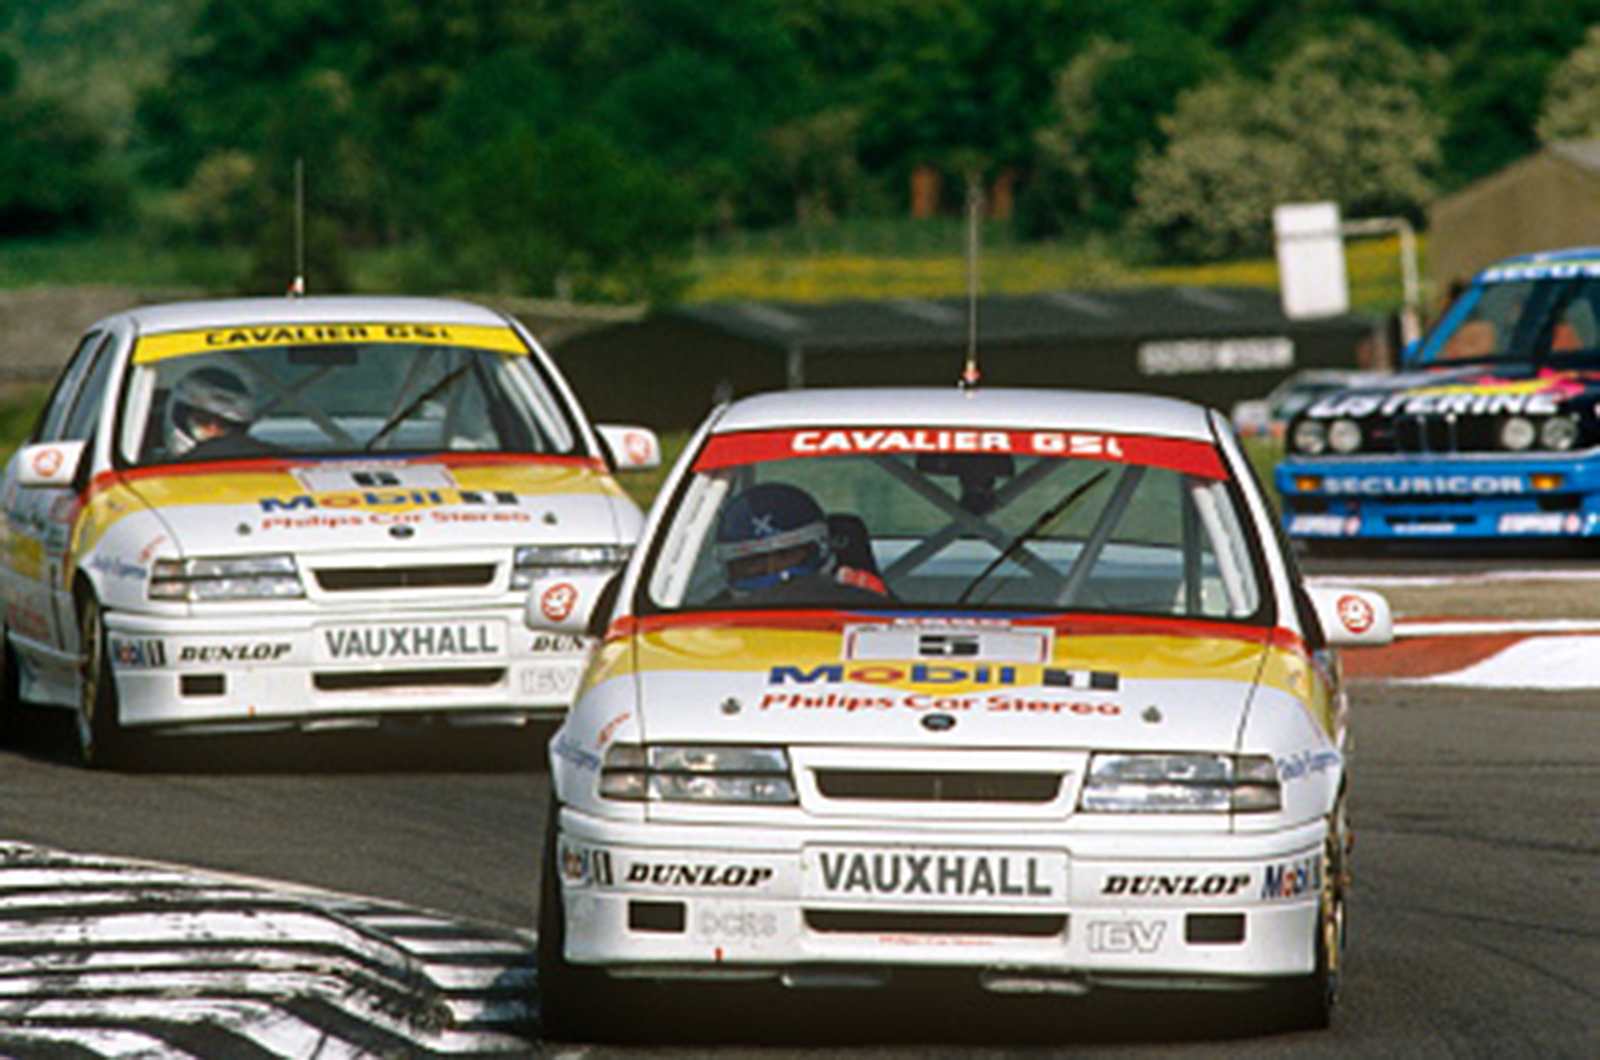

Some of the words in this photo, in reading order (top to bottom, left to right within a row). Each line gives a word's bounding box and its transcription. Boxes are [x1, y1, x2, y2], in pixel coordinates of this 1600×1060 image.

[206, 327, 369, 345] CAVALIER
[1307, 391, 1560, 417] LISTERINE
[791, 431, 1012, 452] CAVALIER
[1325, 475, 1523, 494] SECURICOR
[259, 489, 442, 512] Mobil
[180, 643, 292, 661] DUNLOP
[325, 625, 499, 657] VAUXHALL
[769, 664, 1016, 685] Mobil
[760, 693, 893, 712] Philips
[903, 695, 981, 711] Car
[986, 696, 1122, 716] Stereo
[627, 862, 773, 887] DUNLOP
[819, 852, 1053, 898] VAUXHALL
[1102, 873, 1252, 896] DUNLOP
